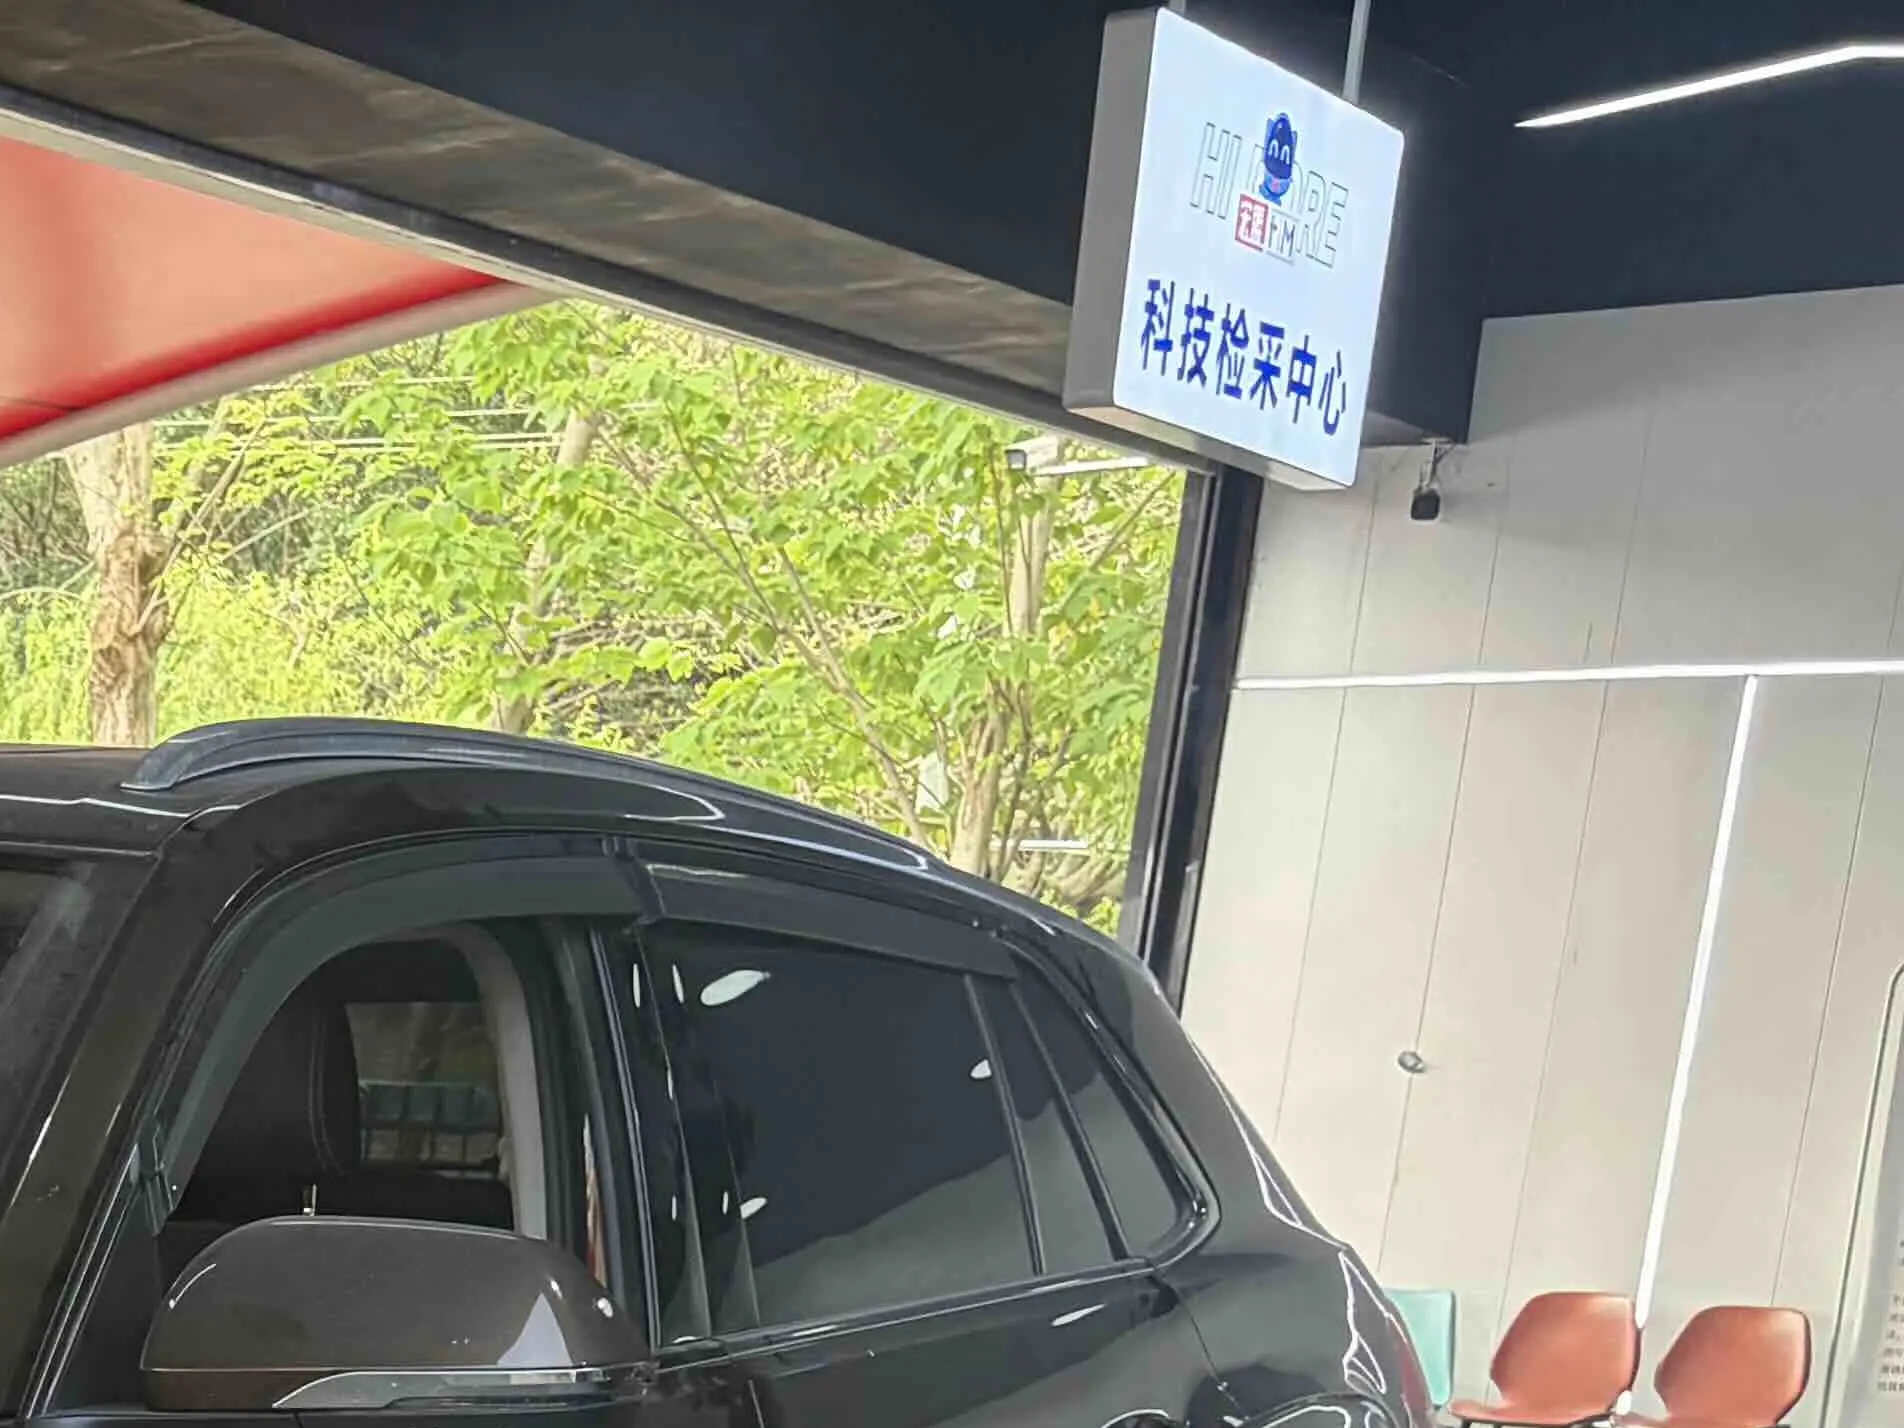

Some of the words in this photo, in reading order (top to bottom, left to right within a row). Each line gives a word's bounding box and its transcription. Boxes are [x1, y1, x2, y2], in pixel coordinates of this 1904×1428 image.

[1140, 279, 1348, 435] 科技检采中心
